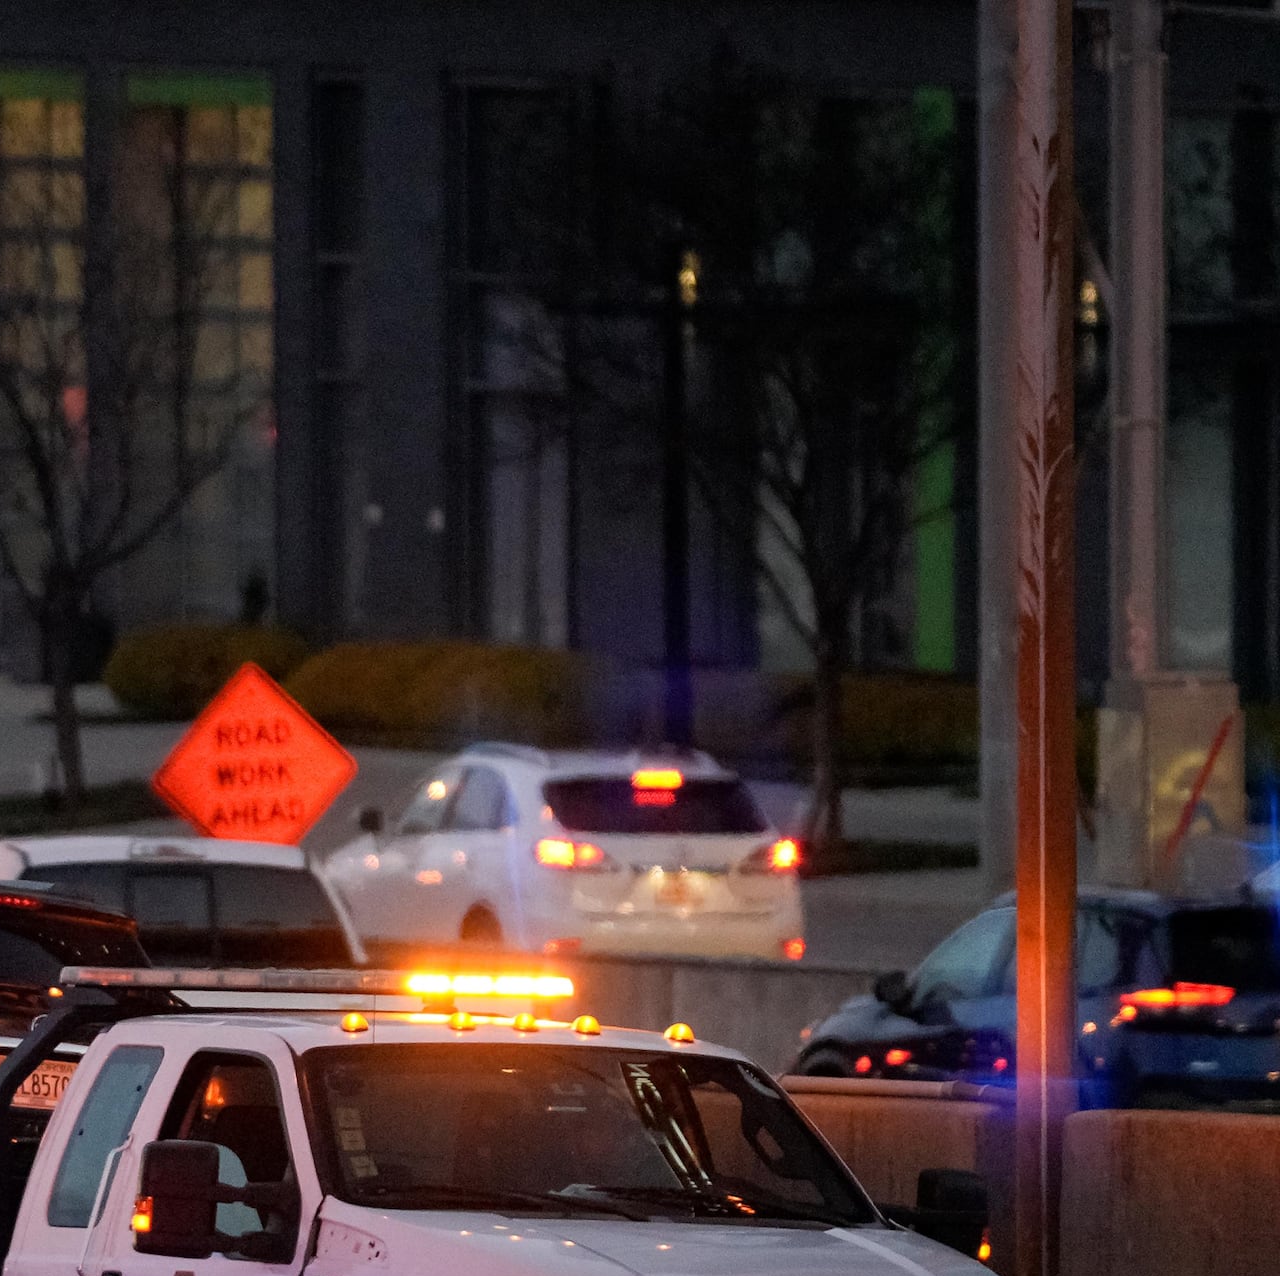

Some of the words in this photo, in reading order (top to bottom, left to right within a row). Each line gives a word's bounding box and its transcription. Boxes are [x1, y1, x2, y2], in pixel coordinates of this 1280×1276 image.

[216, 719, 291, 748] ROAD
[216, 763, 290, 788] WORK
[211, 800, 307, 828] AHEAD
